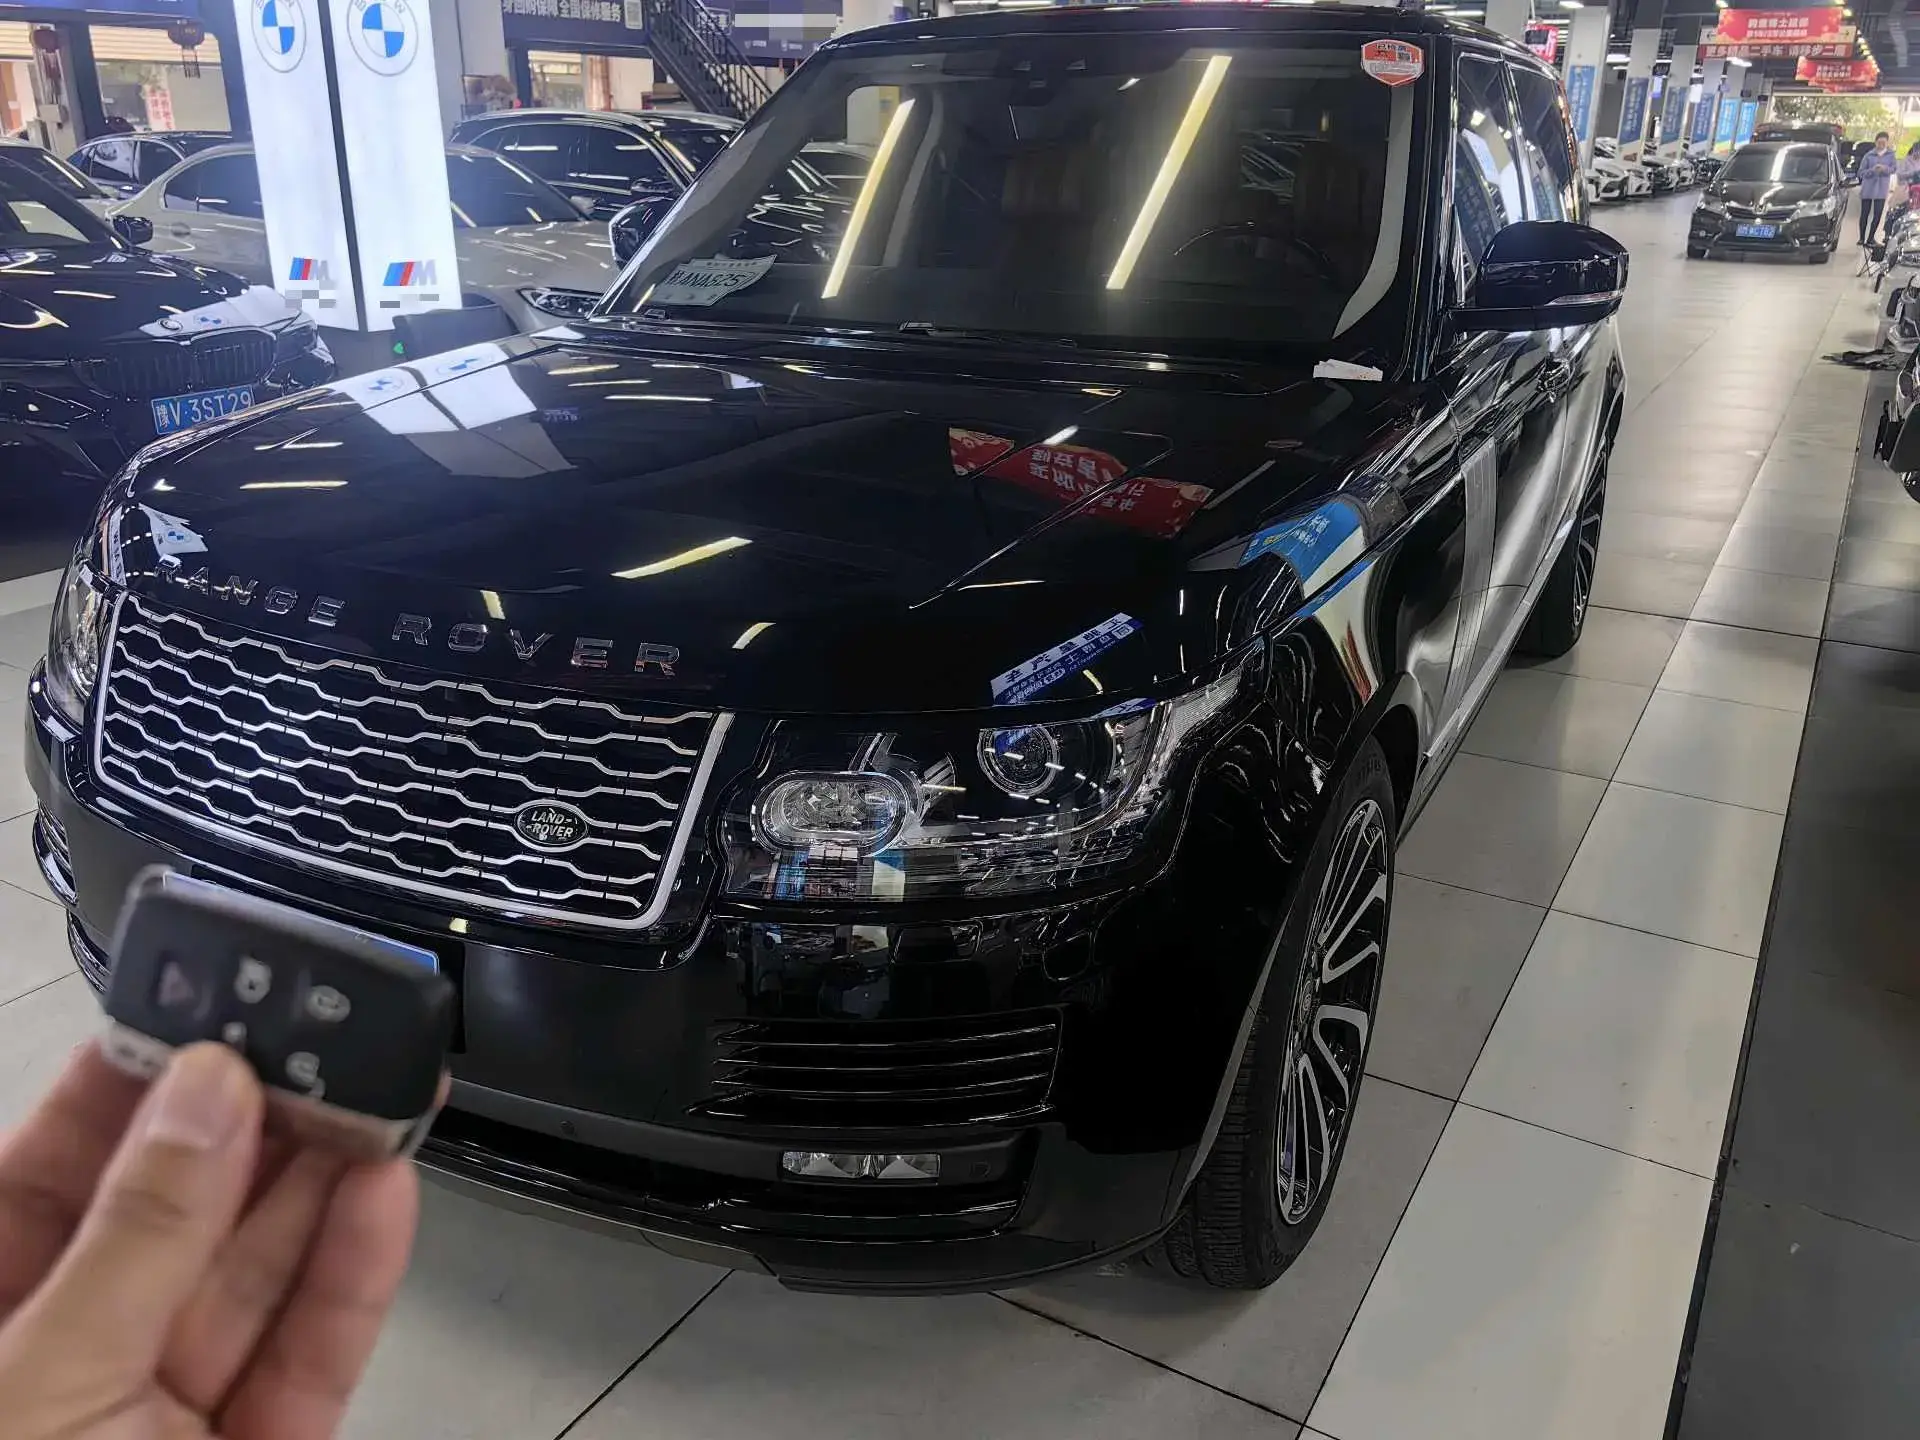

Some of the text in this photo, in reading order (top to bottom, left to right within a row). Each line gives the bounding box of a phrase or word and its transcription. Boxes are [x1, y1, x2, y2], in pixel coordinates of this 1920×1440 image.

[153, 555, 681, 677] RANGE ROVER
[531, 810, 565, 825] LAND
[533, 822, 574, 838] ROVER
